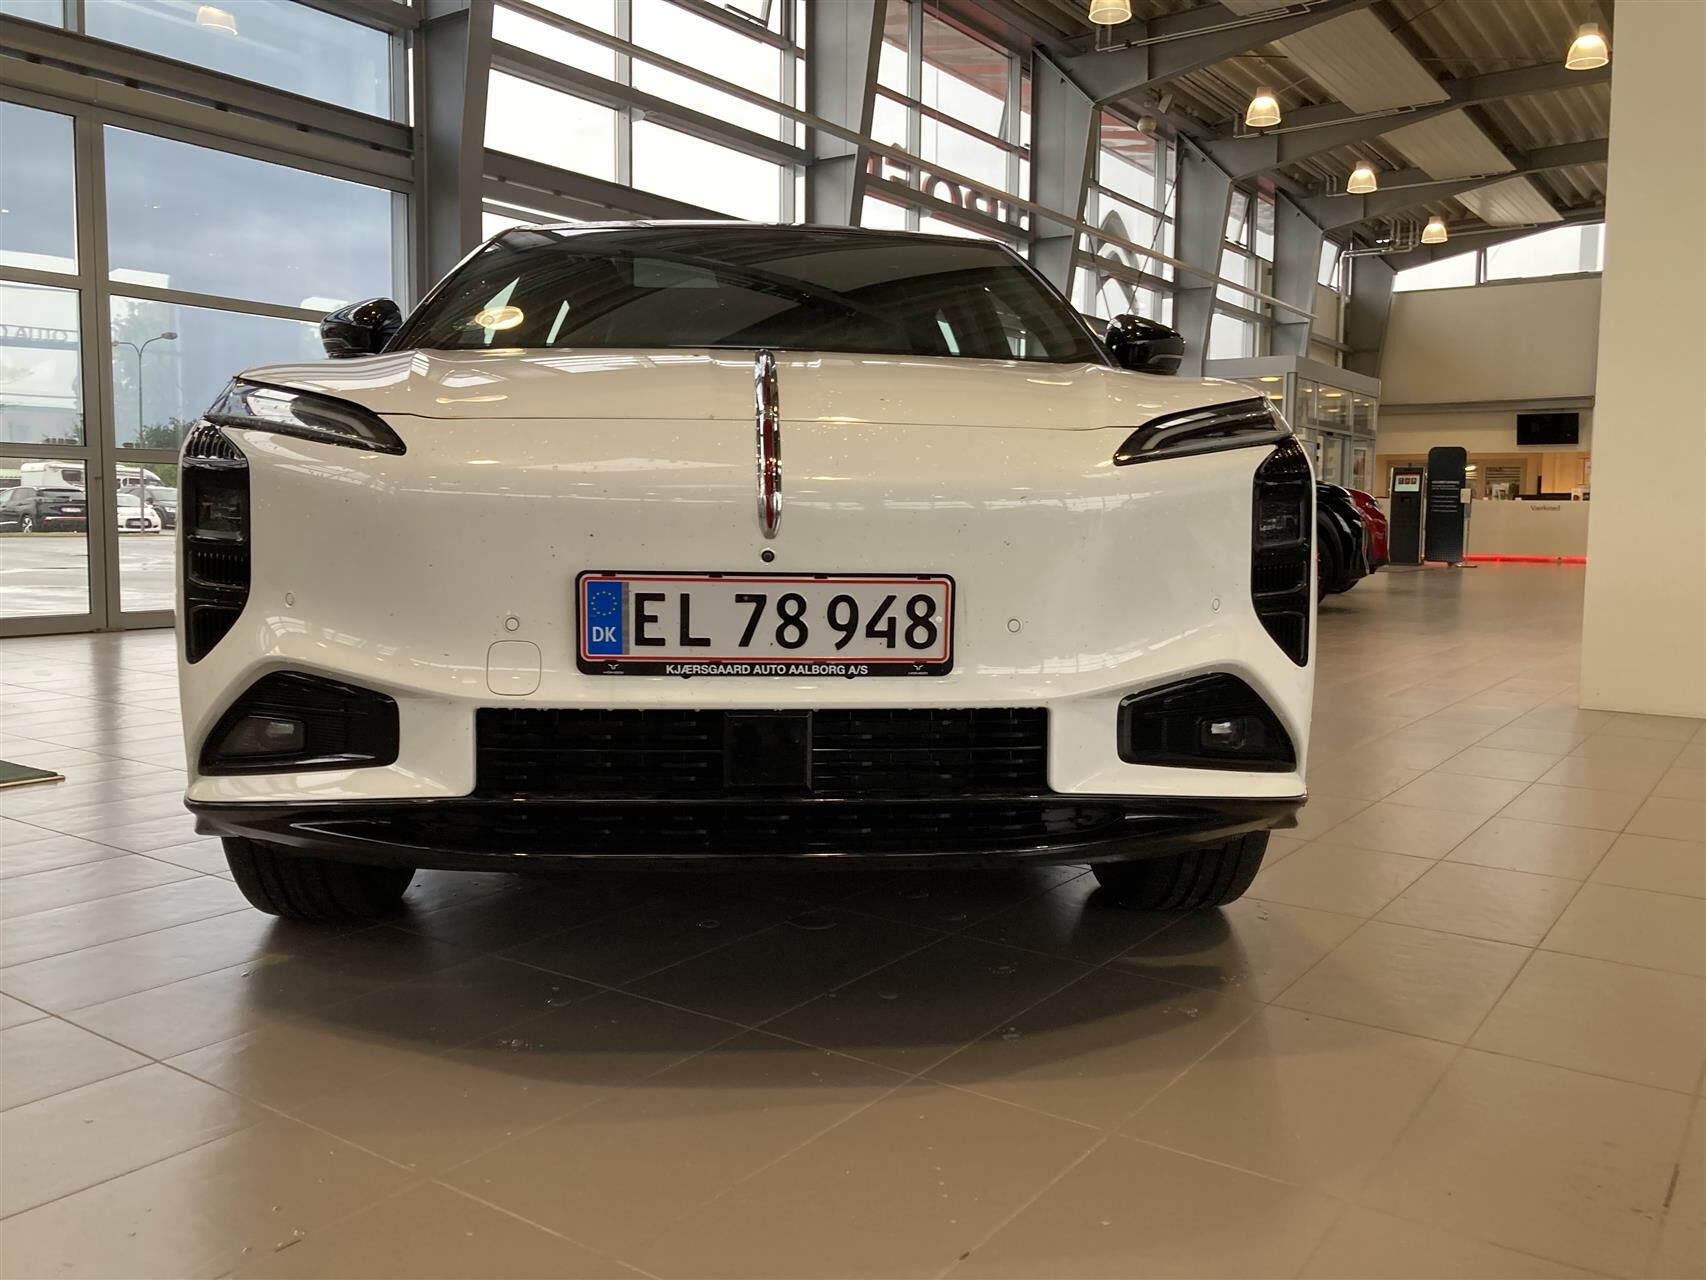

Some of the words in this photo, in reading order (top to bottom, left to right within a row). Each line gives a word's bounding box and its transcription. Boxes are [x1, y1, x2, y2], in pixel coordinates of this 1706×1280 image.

[634, 592, 712, 647] EL
[735, 592, 809, 650] 78
[826, 593, 938, 651] 948
[592, 626, 617, 643] DK
[665, 664, 751, 675] KJÆRSGAARD
[752, 664, 787, 675] AUTO
[788, 664, 846, 676] AALBORG
[847, 665, 869, 676] A/S
